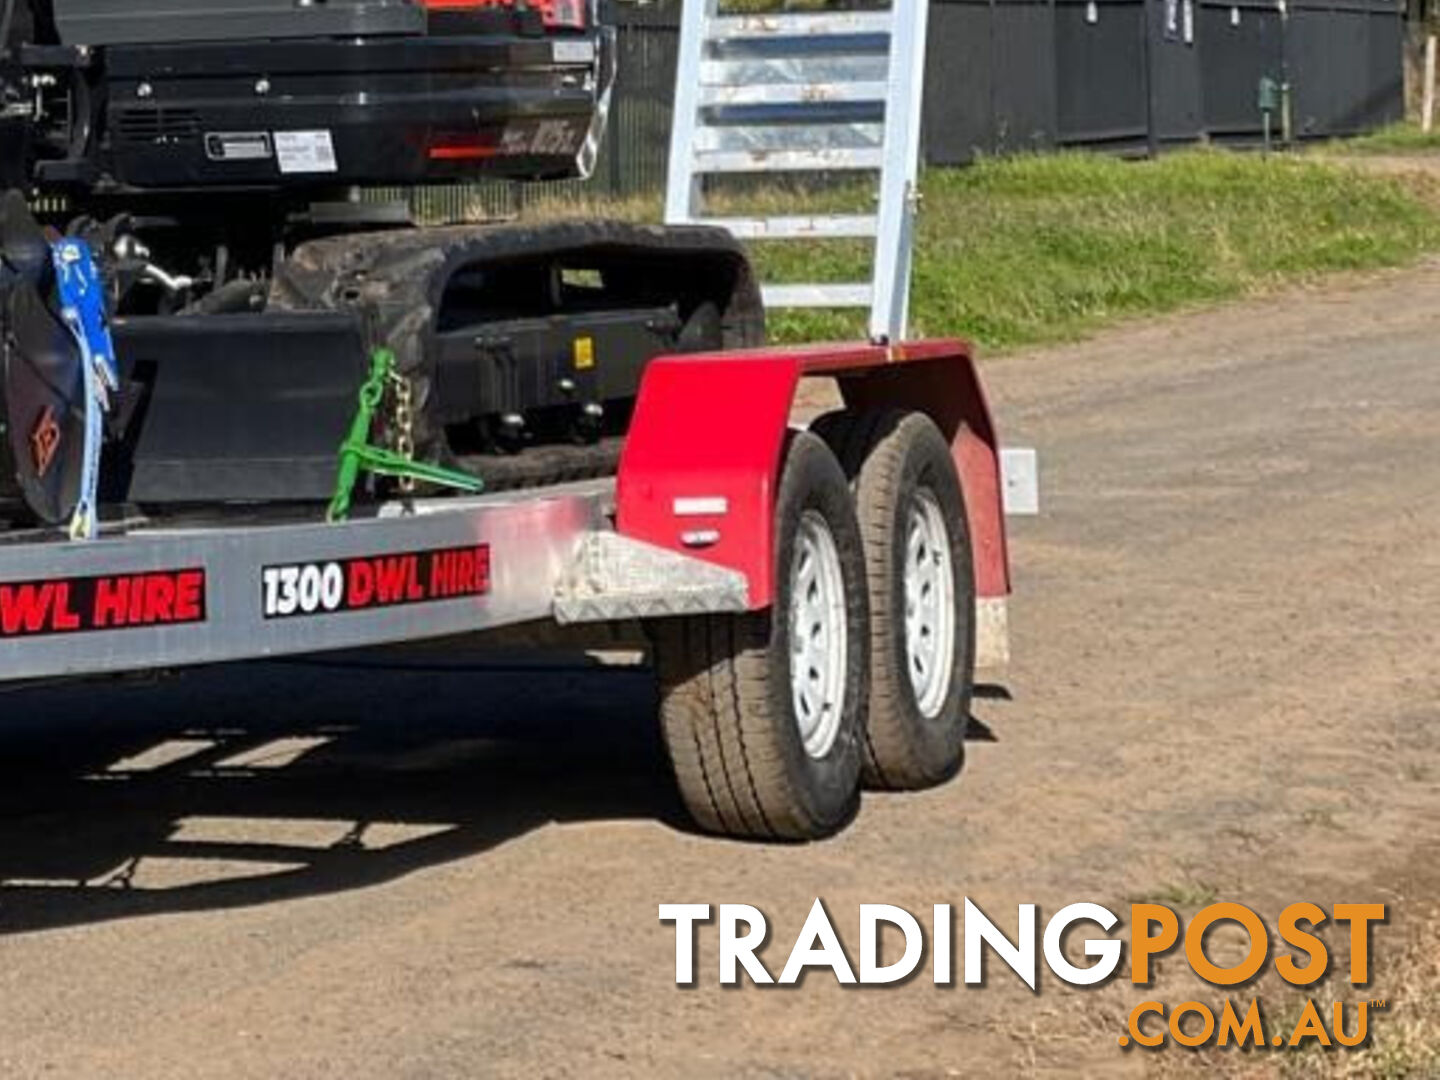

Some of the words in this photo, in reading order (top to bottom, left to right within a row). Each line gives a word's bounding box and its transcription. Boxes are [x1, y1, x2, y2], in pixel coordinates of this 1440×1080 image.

[94, 572, 204, 626] HIRE
[264, 562, 344, 615] 1300
[348, 556, 423, 607] DWL
[430, 545, 490, 598] HIRE
